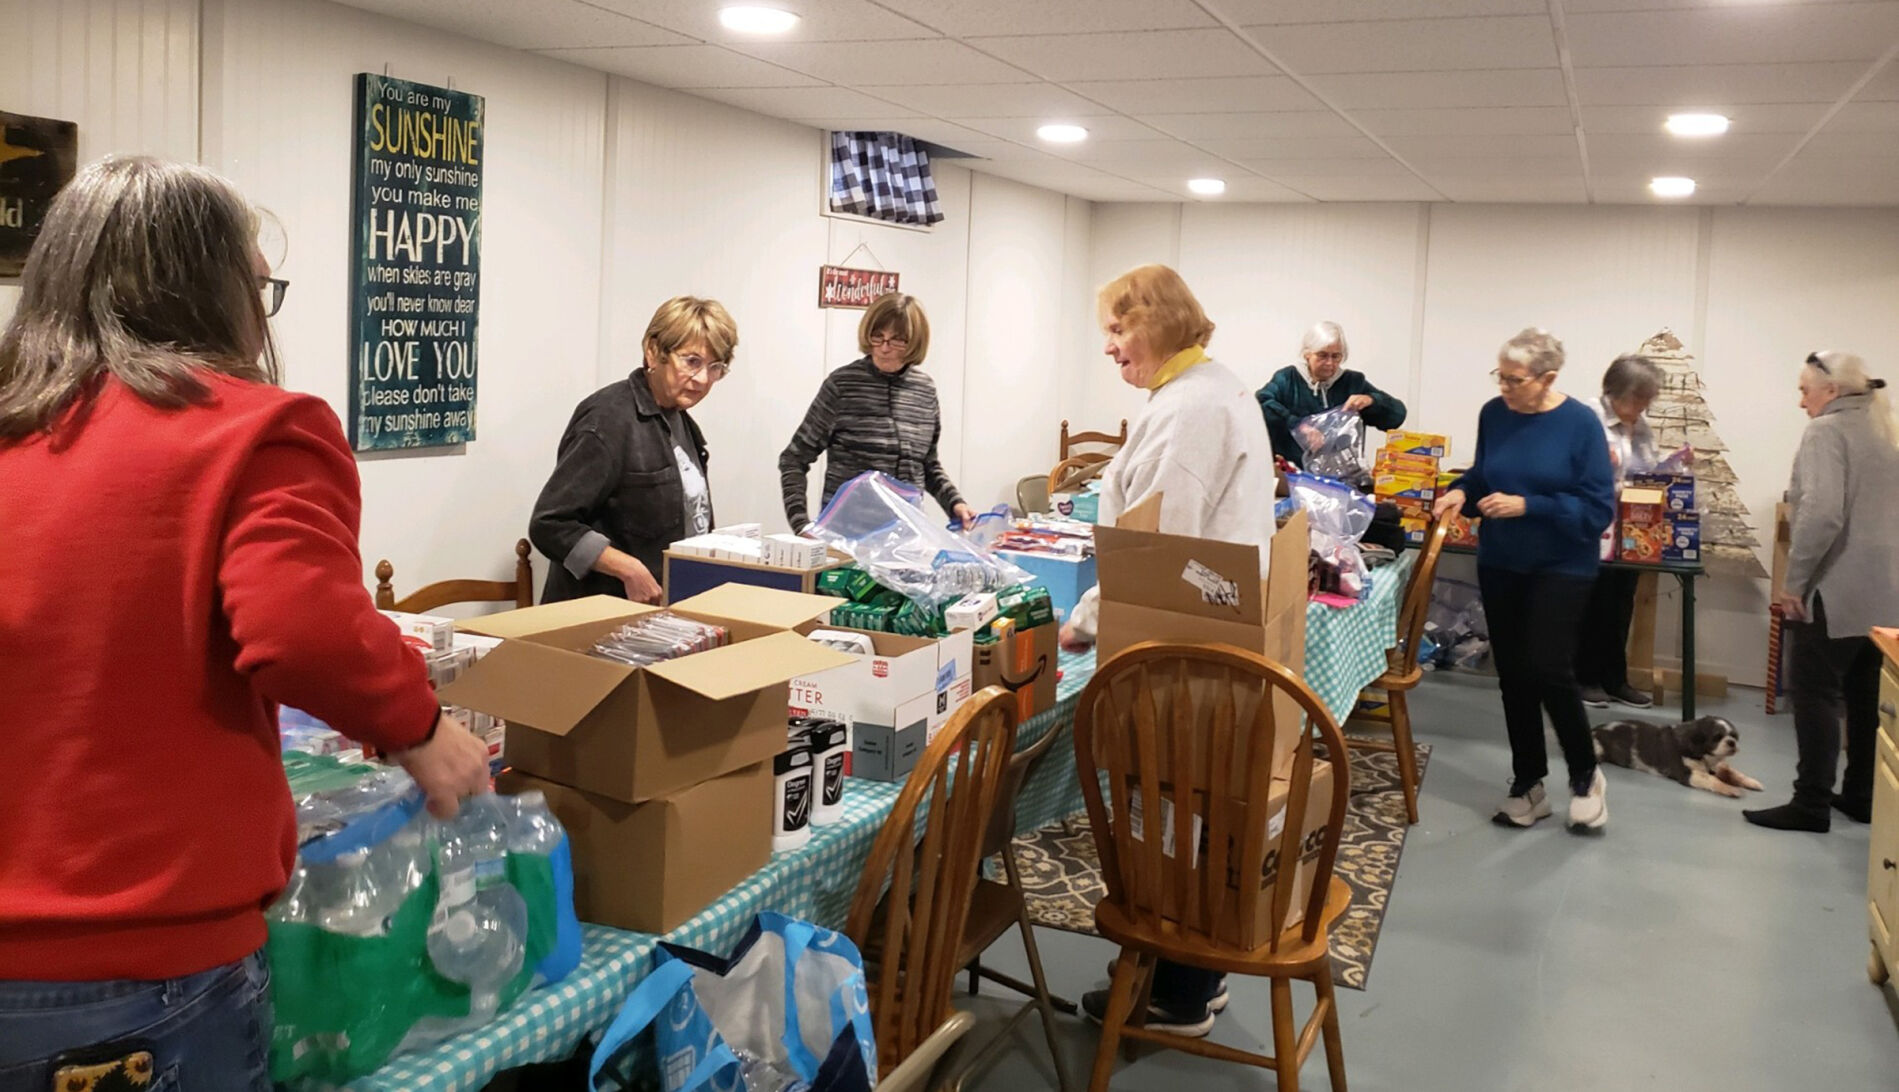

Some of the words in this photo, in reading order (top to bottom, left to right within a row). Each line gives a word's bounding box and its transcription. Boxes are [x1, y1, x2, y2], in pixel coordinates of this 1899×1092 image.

[378, 81, 403, 101] You
[407, 91, 429, 106] are
[432, 96, 452, 115] my
[370, 103, 479, 166] SUNSHINE
[371, 158, 392, 181] my
[395, 160, 422, 185] only
[425, 165, 479, 188] sunshine
[371, 186, 403, 205] you
[408, 189, 452, 209] make
[455, 196, 479, 211] me
[369, 208, 478, 266] HAPPY
[368, 264, 400, 283] when
[402, 265, 432, 285] skies
[433, 270, 452, 286] are
[453, 271, 477, 292] gray
[367, 292, 395, 316] you'll
[396, 296, 426, 312] never
[427, 293, 454, 313] know
[454, 294, 476, 313] dear
[381, 319, 419, 337] HOW
[420, 320, 460, 337] MUCH
[461, 320, 466, 337] I
[363, 340, 420, 382] LOVE
[432, 340, 477, 380] YOU
[362, 385, 410, 407] please
[412, 383, 446, 405] don't
[447, 382, 475, 402] take
[362, 415, 383, 438] my
[384, 407, 441, 432] sunshine
[443, 410, 473, 431] away
